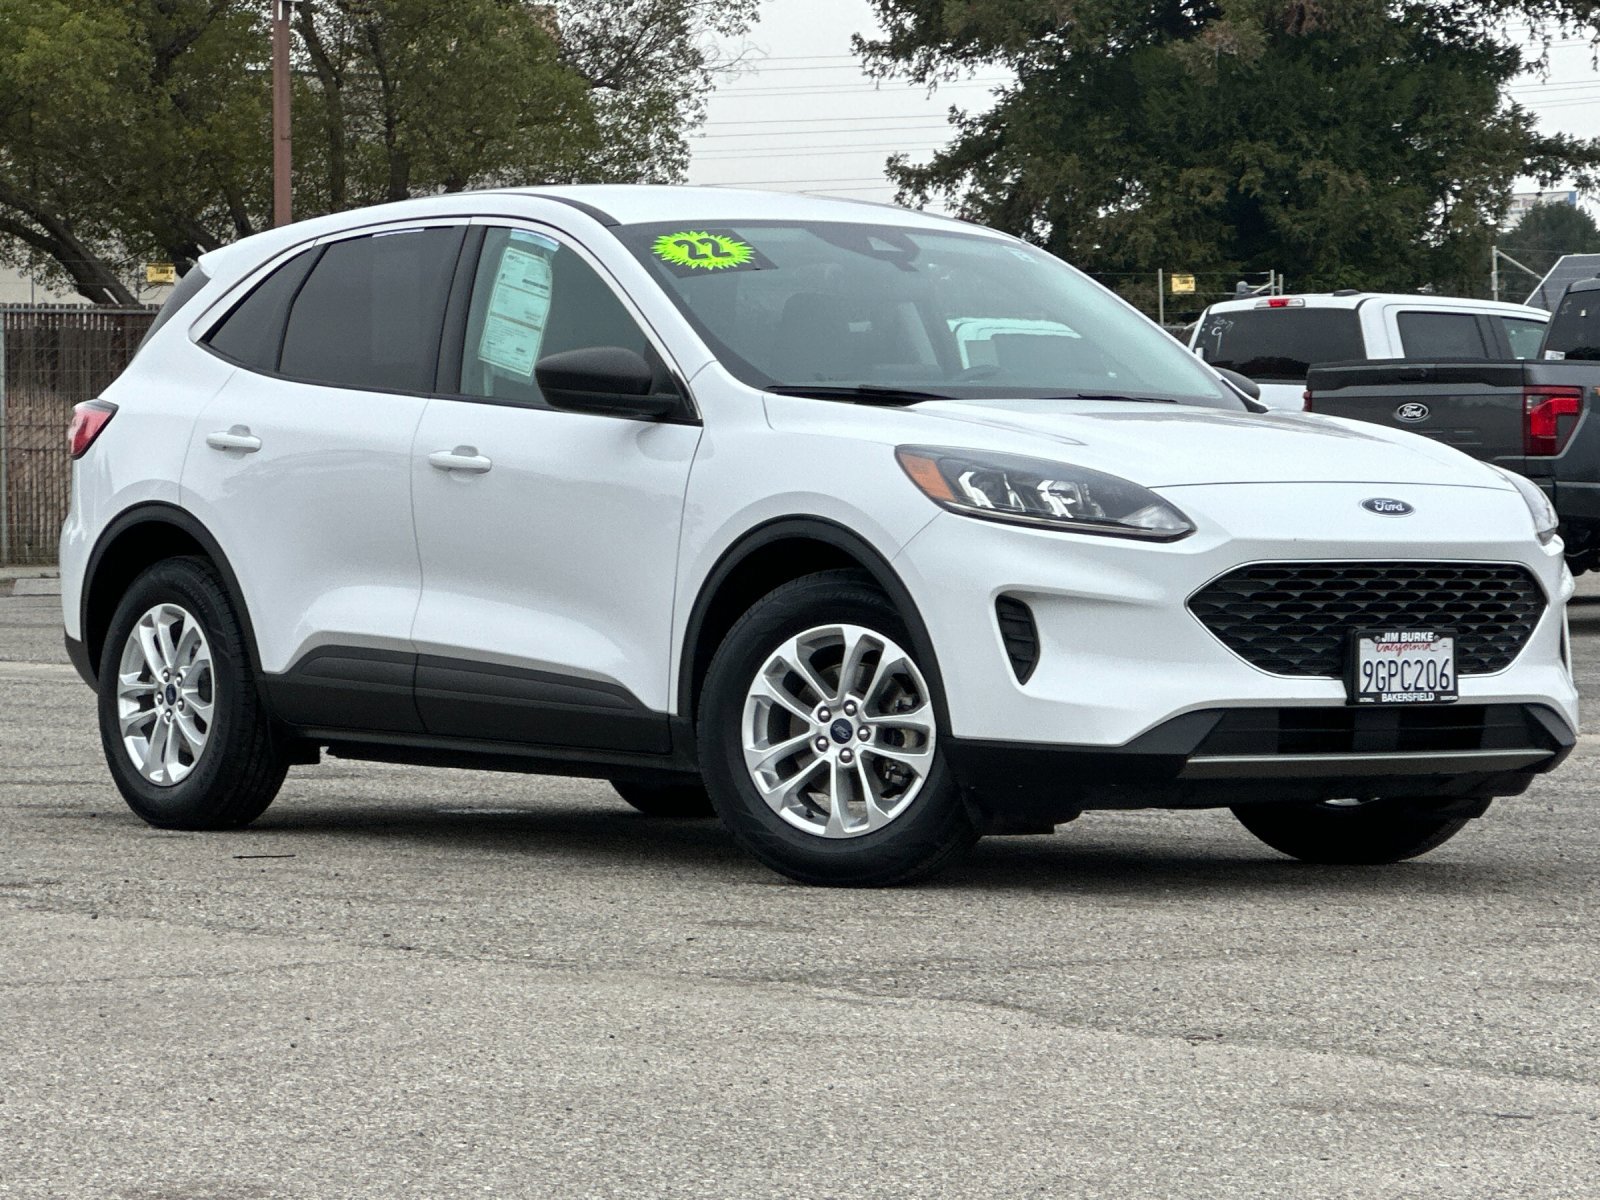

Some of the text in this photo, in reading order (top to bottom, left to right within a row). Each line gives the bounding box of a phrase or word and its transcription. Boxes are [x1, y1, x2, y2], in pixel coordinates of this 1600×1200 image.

[673, 238, 732, 259] 22
[1402, 405, 1423, 417] Ford
[1374, 500, 1405, 511] Ford
[1382, 632, 1434, 642] JIM BURKE
[1363, 658, 1450, 692] 9GPC206
[1381, 692, 1435, 702] BAKERSFIELD
